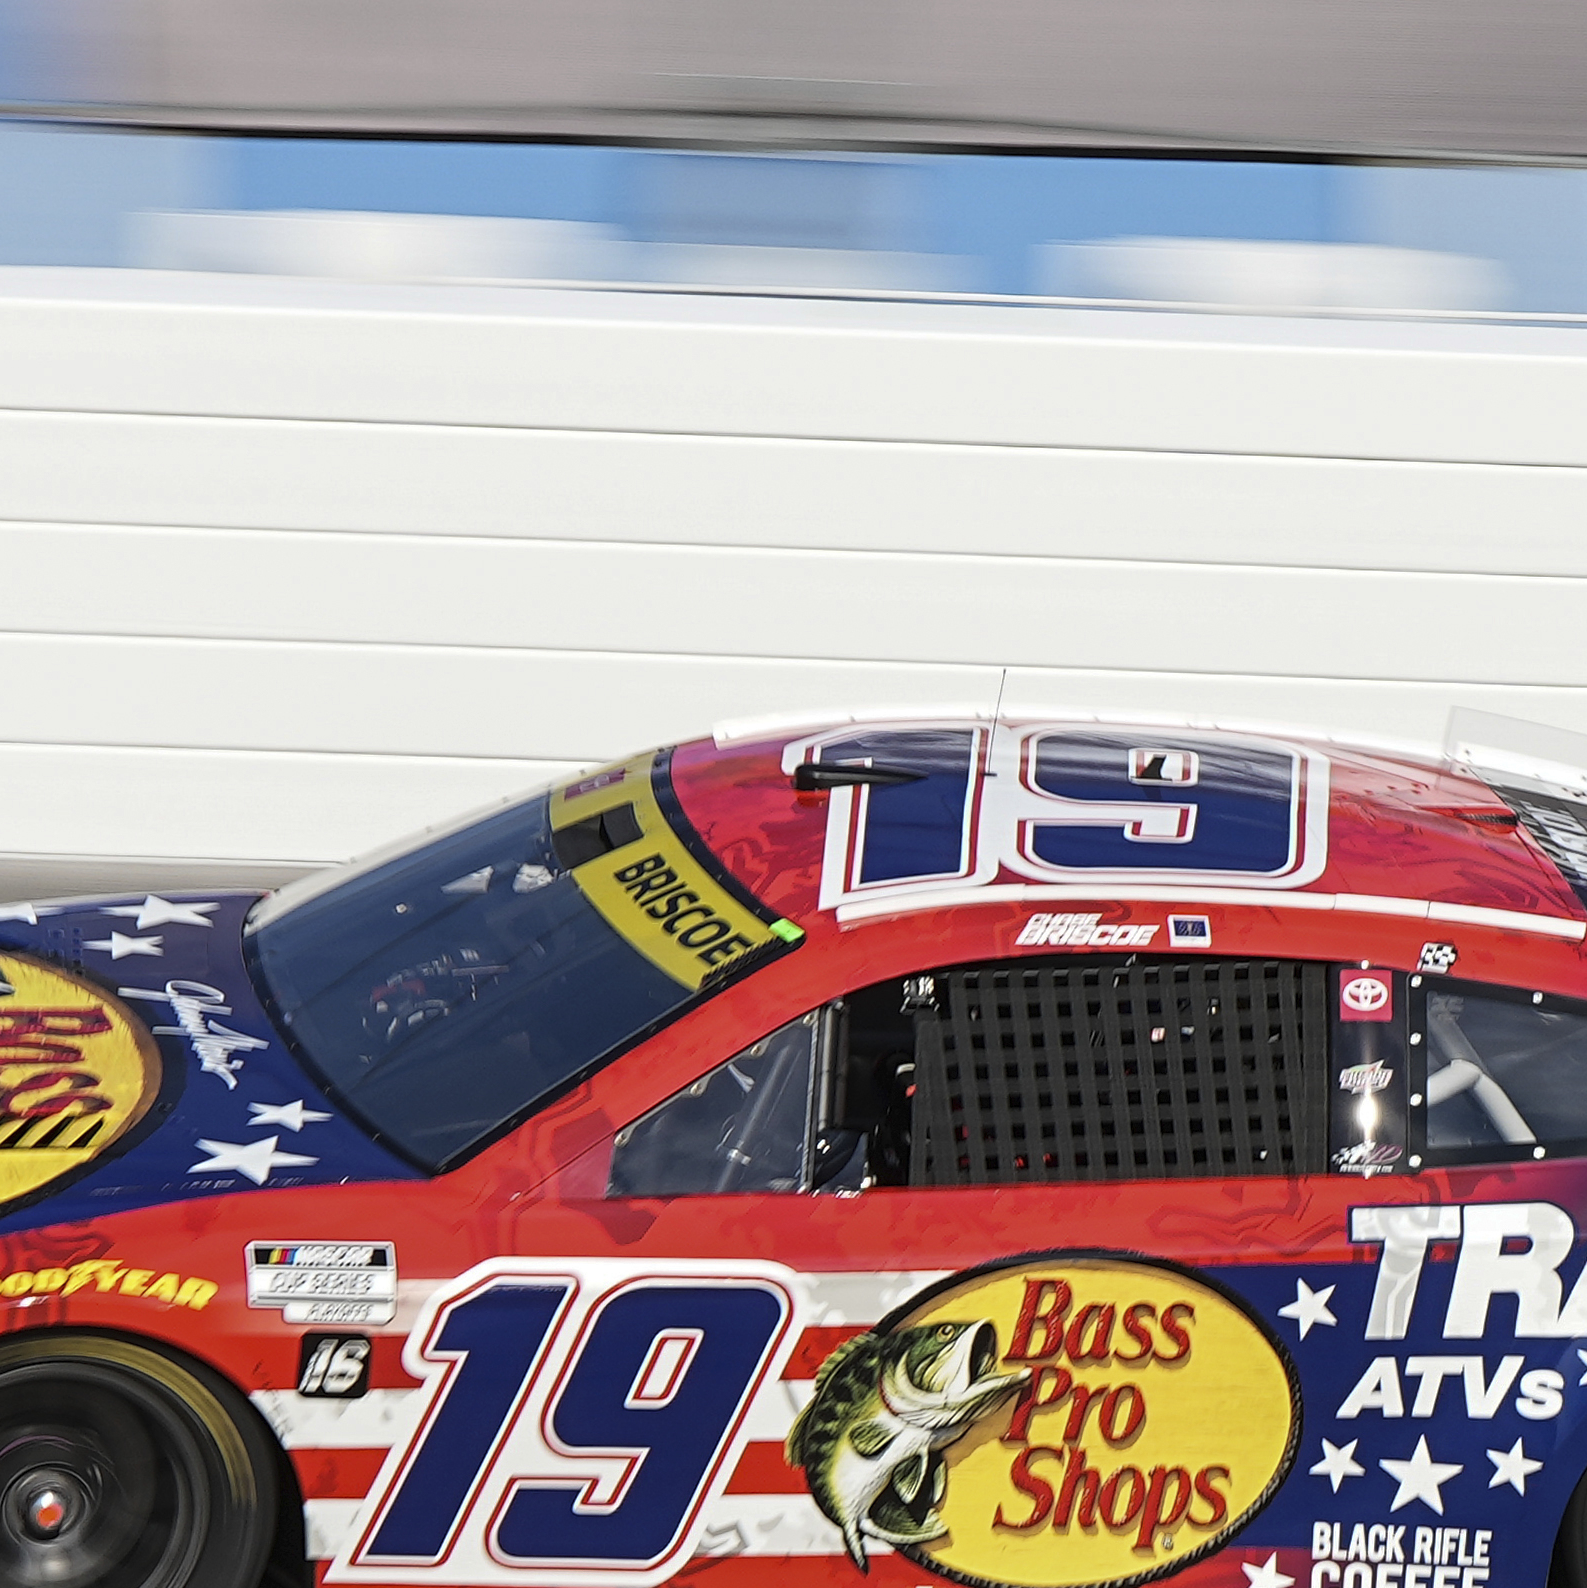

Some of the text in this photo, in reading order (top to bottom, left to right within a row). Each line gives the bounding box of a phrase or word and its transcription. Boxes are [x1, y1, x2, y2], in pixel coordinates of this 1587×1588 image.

[802, 722, 1317, 900] 19
[613, 852, 750, 967] BRISCOE
[1014, 924, 1160, 947] BRISCOE
[269, 1271, 375, 1295] CUP SERIES
[293, 1245, 375, 1267] NASCAR
[1001, 1275, 1195, 1363] Bass
[298, 1337, 371, 1394] 16
[1335, 1354, 1564, 1420] ATVs
[349, 1272, 794, 1572] 19
[999, 1365, 1146, 1446] Pro
[992, 1444, 1232, 1556] Shops
[1311, 1520, 1494, 1568] BLACK RIFLE
